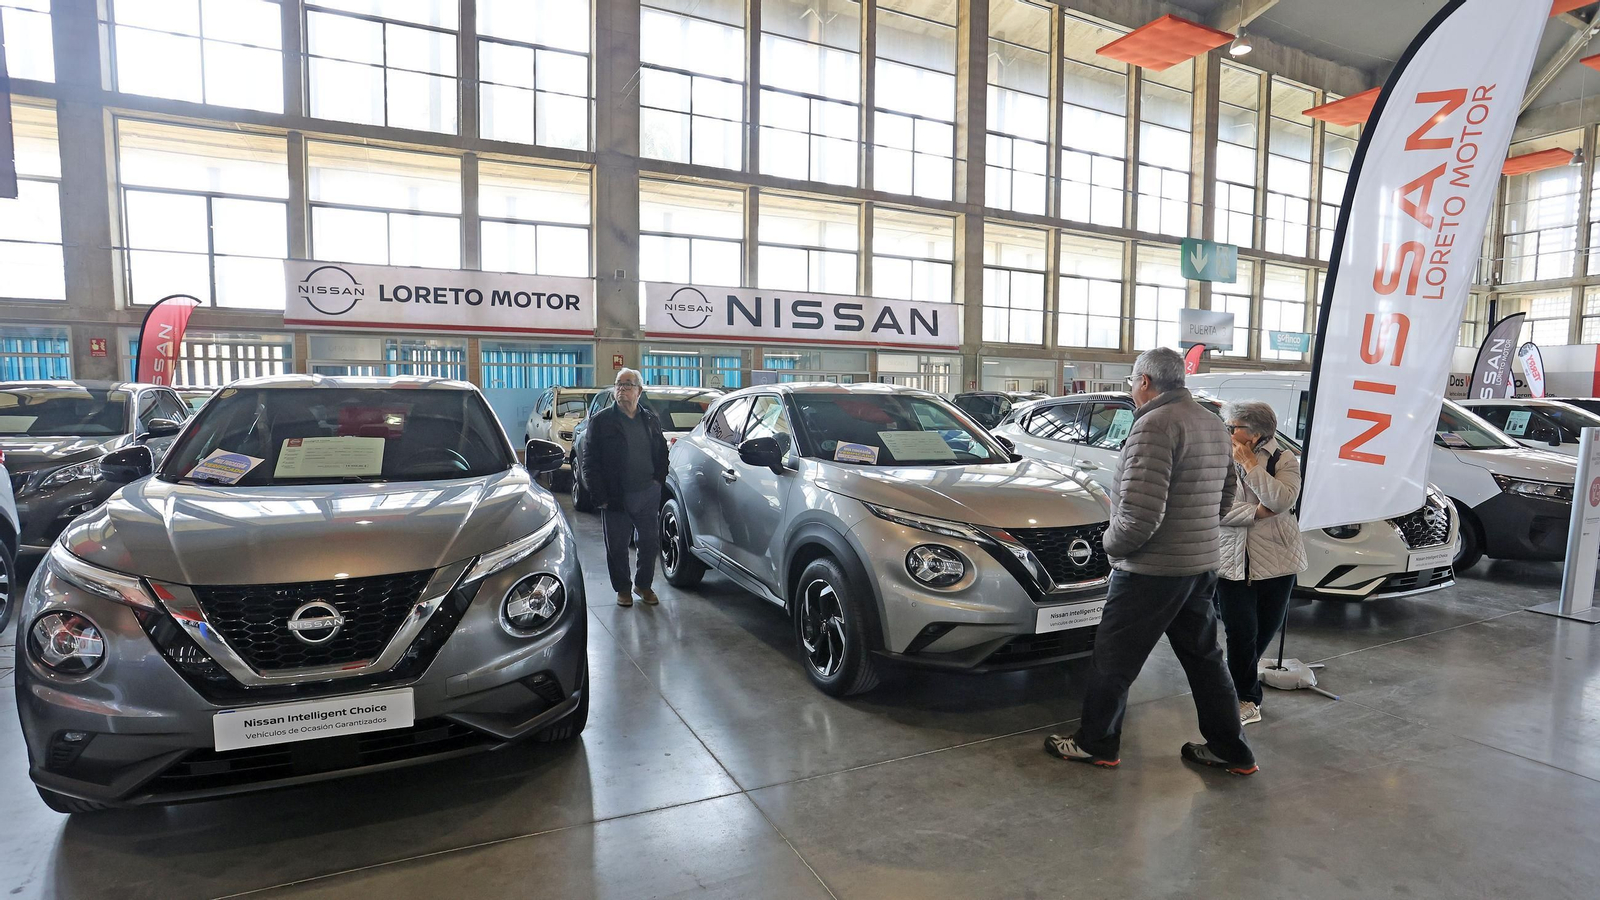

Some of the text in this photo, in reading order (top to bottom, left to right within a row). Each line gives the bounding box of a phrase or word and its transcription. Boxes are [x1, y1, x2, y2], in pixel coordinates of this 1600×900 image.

[1423, 83, 1497, 299] LORETO MOTOR
[1338, 87, 1468, 466] NISSAN
[298, 284, 365, 296] NISSAN
[379, 284, 581, 311] LORETO MOTOR
[664, 303, 714, 313] NISSAN
[727, 295, 939, 336] NISSAN
[1189, 323, 1217, 336] PUERTA
[1450, 374, 1465, 387] Das
[289, 618, 344, 629] NISSAN
[243, 704, 388, 728] Nissan Intelligent Choice
[245, 716, 388, 740] Vehículos de Ocasión Garantizados
